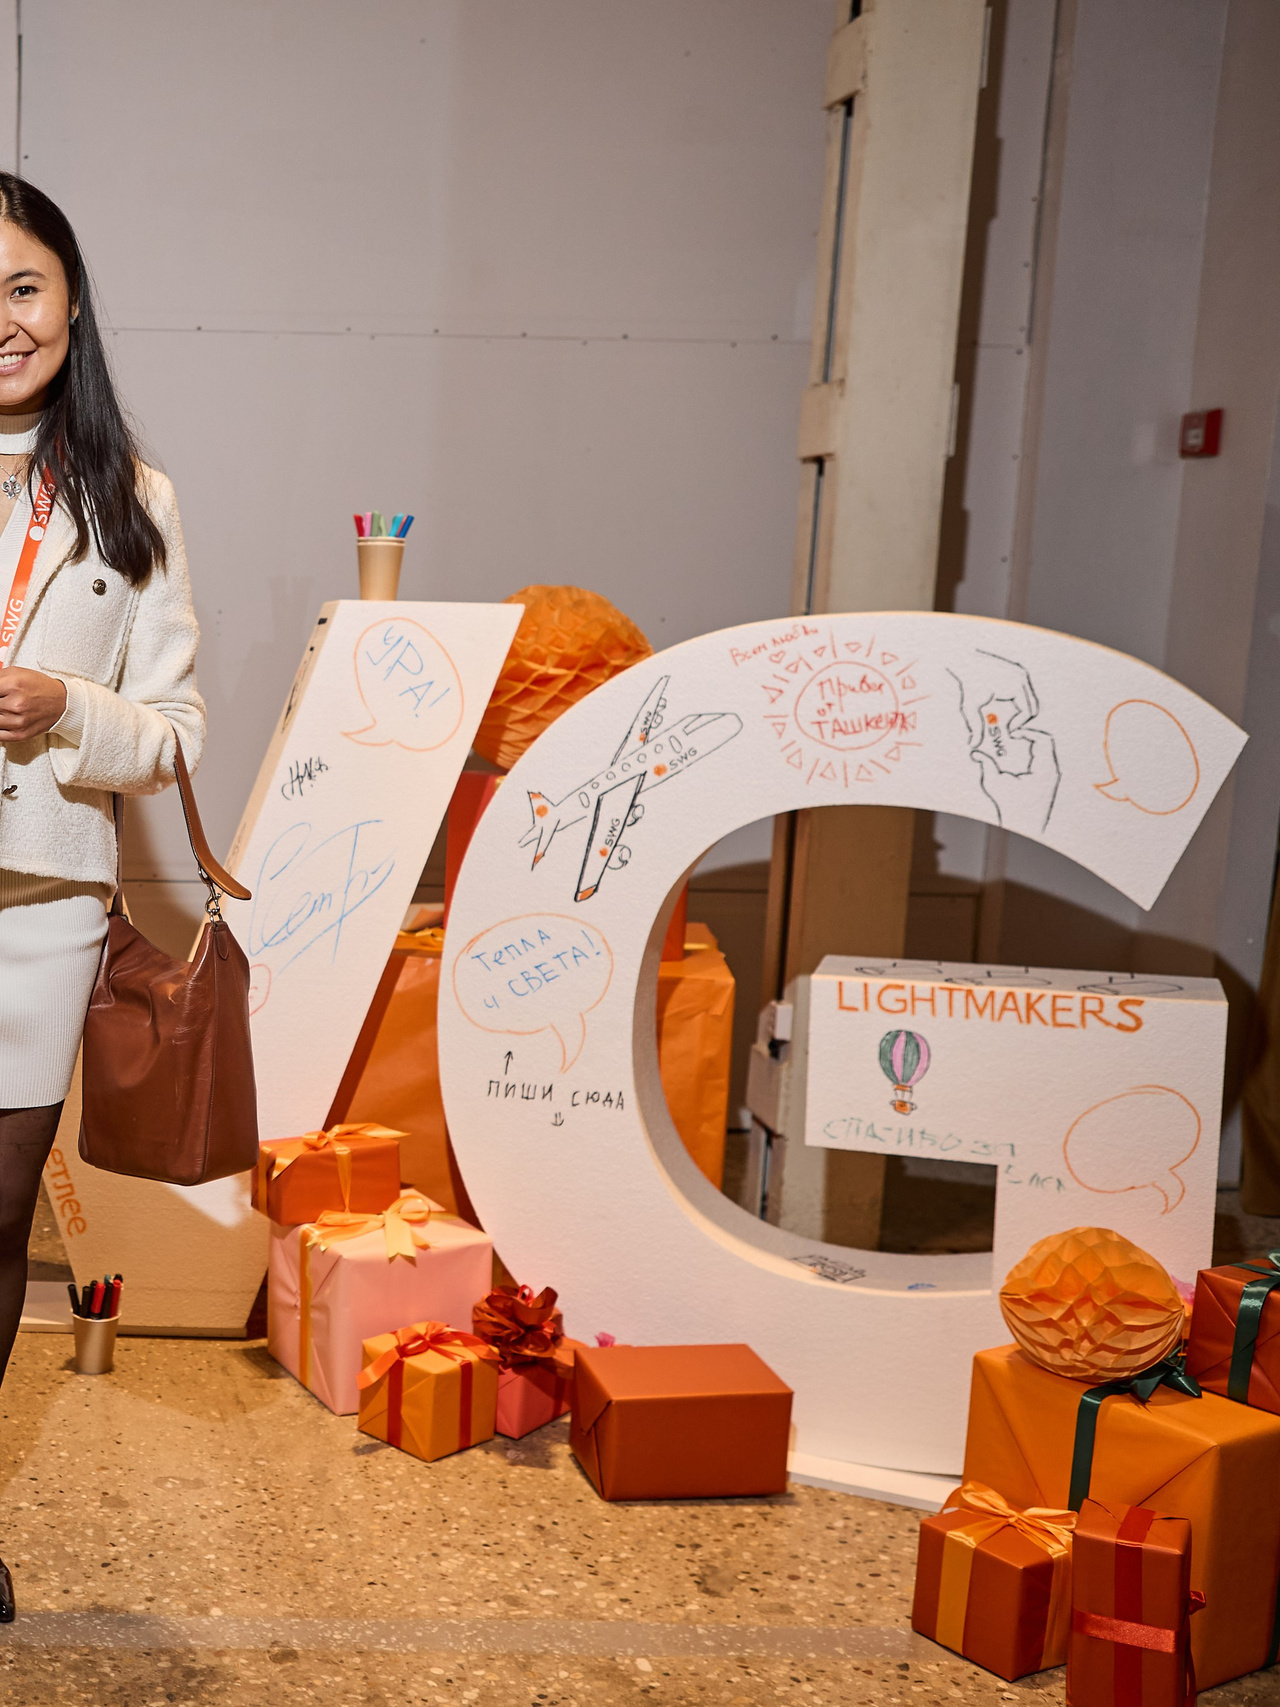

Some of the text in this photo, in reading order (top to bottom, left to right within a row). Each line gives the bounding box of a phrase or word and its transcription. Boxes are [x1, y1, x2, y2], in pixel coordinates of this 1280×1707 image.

[34, 482, 55, 525] SWG
[2, 599, 24, 642] SWG
[988, 725, 1007, 757] SWG
[669, 747, 698, 770] SWG
[604, 818, 621, 847] SWG
[837, 981, 1145, 1034] LIGHTMAKERS
[487, 1080, 625, 1111] ПИШИ СЮДА
